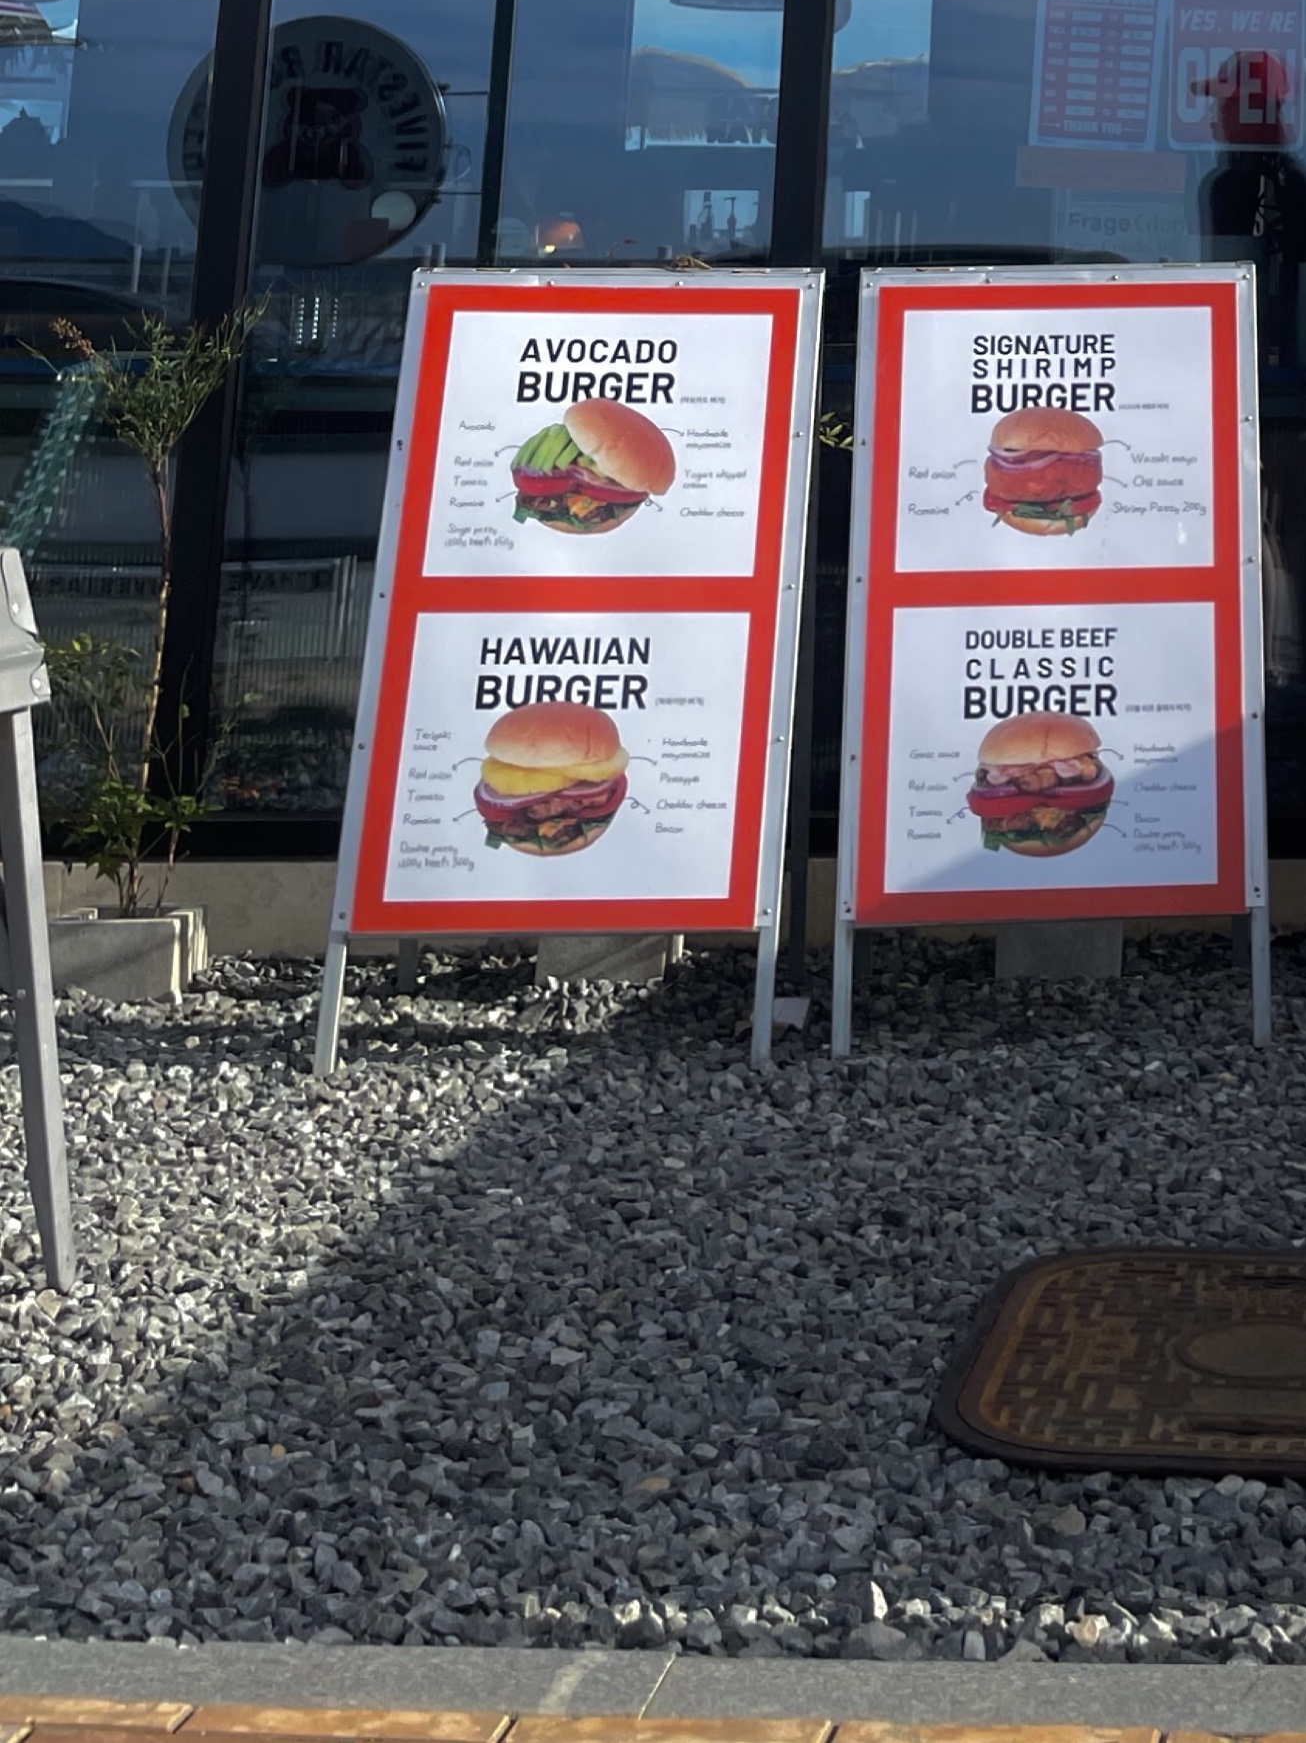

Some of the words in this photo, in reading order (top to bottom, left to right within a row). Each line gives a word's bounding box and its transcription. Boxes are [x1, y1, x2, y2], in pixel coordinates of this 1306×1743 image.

[1180, 8, 1222, 34] YES,
[1231, 9, 1297, 33] WE'RE
[1176, 46, 1297, 125] OPEN
[520, 338, 678, 363] AVOCADO
[973, 334, 1116, 356] SIGNATURE
[973, 357, 1116, 379] SHIRIMP
[515, 370, 676, 405] BURGER
[971, 382, 1116, 414] BURGER
[908, 465, 930, 480] Red
[931, 470, 957, 480] onion
[908, 502, 950, 516] Romaine
[480, 637, 651, 665] HAWAIIAN
[965, 628, 1055, 651] DOUBLE
[1060, 626, 1118, 649] BEEF
[966, 657, 1115, 680] CLASSIC
[474, 674, 649, 712] BURGER
[963, 683, 1119, 720] BURGER
[408, 767, 428, 780] Red
[655, 822, 684, 834] Bacon
